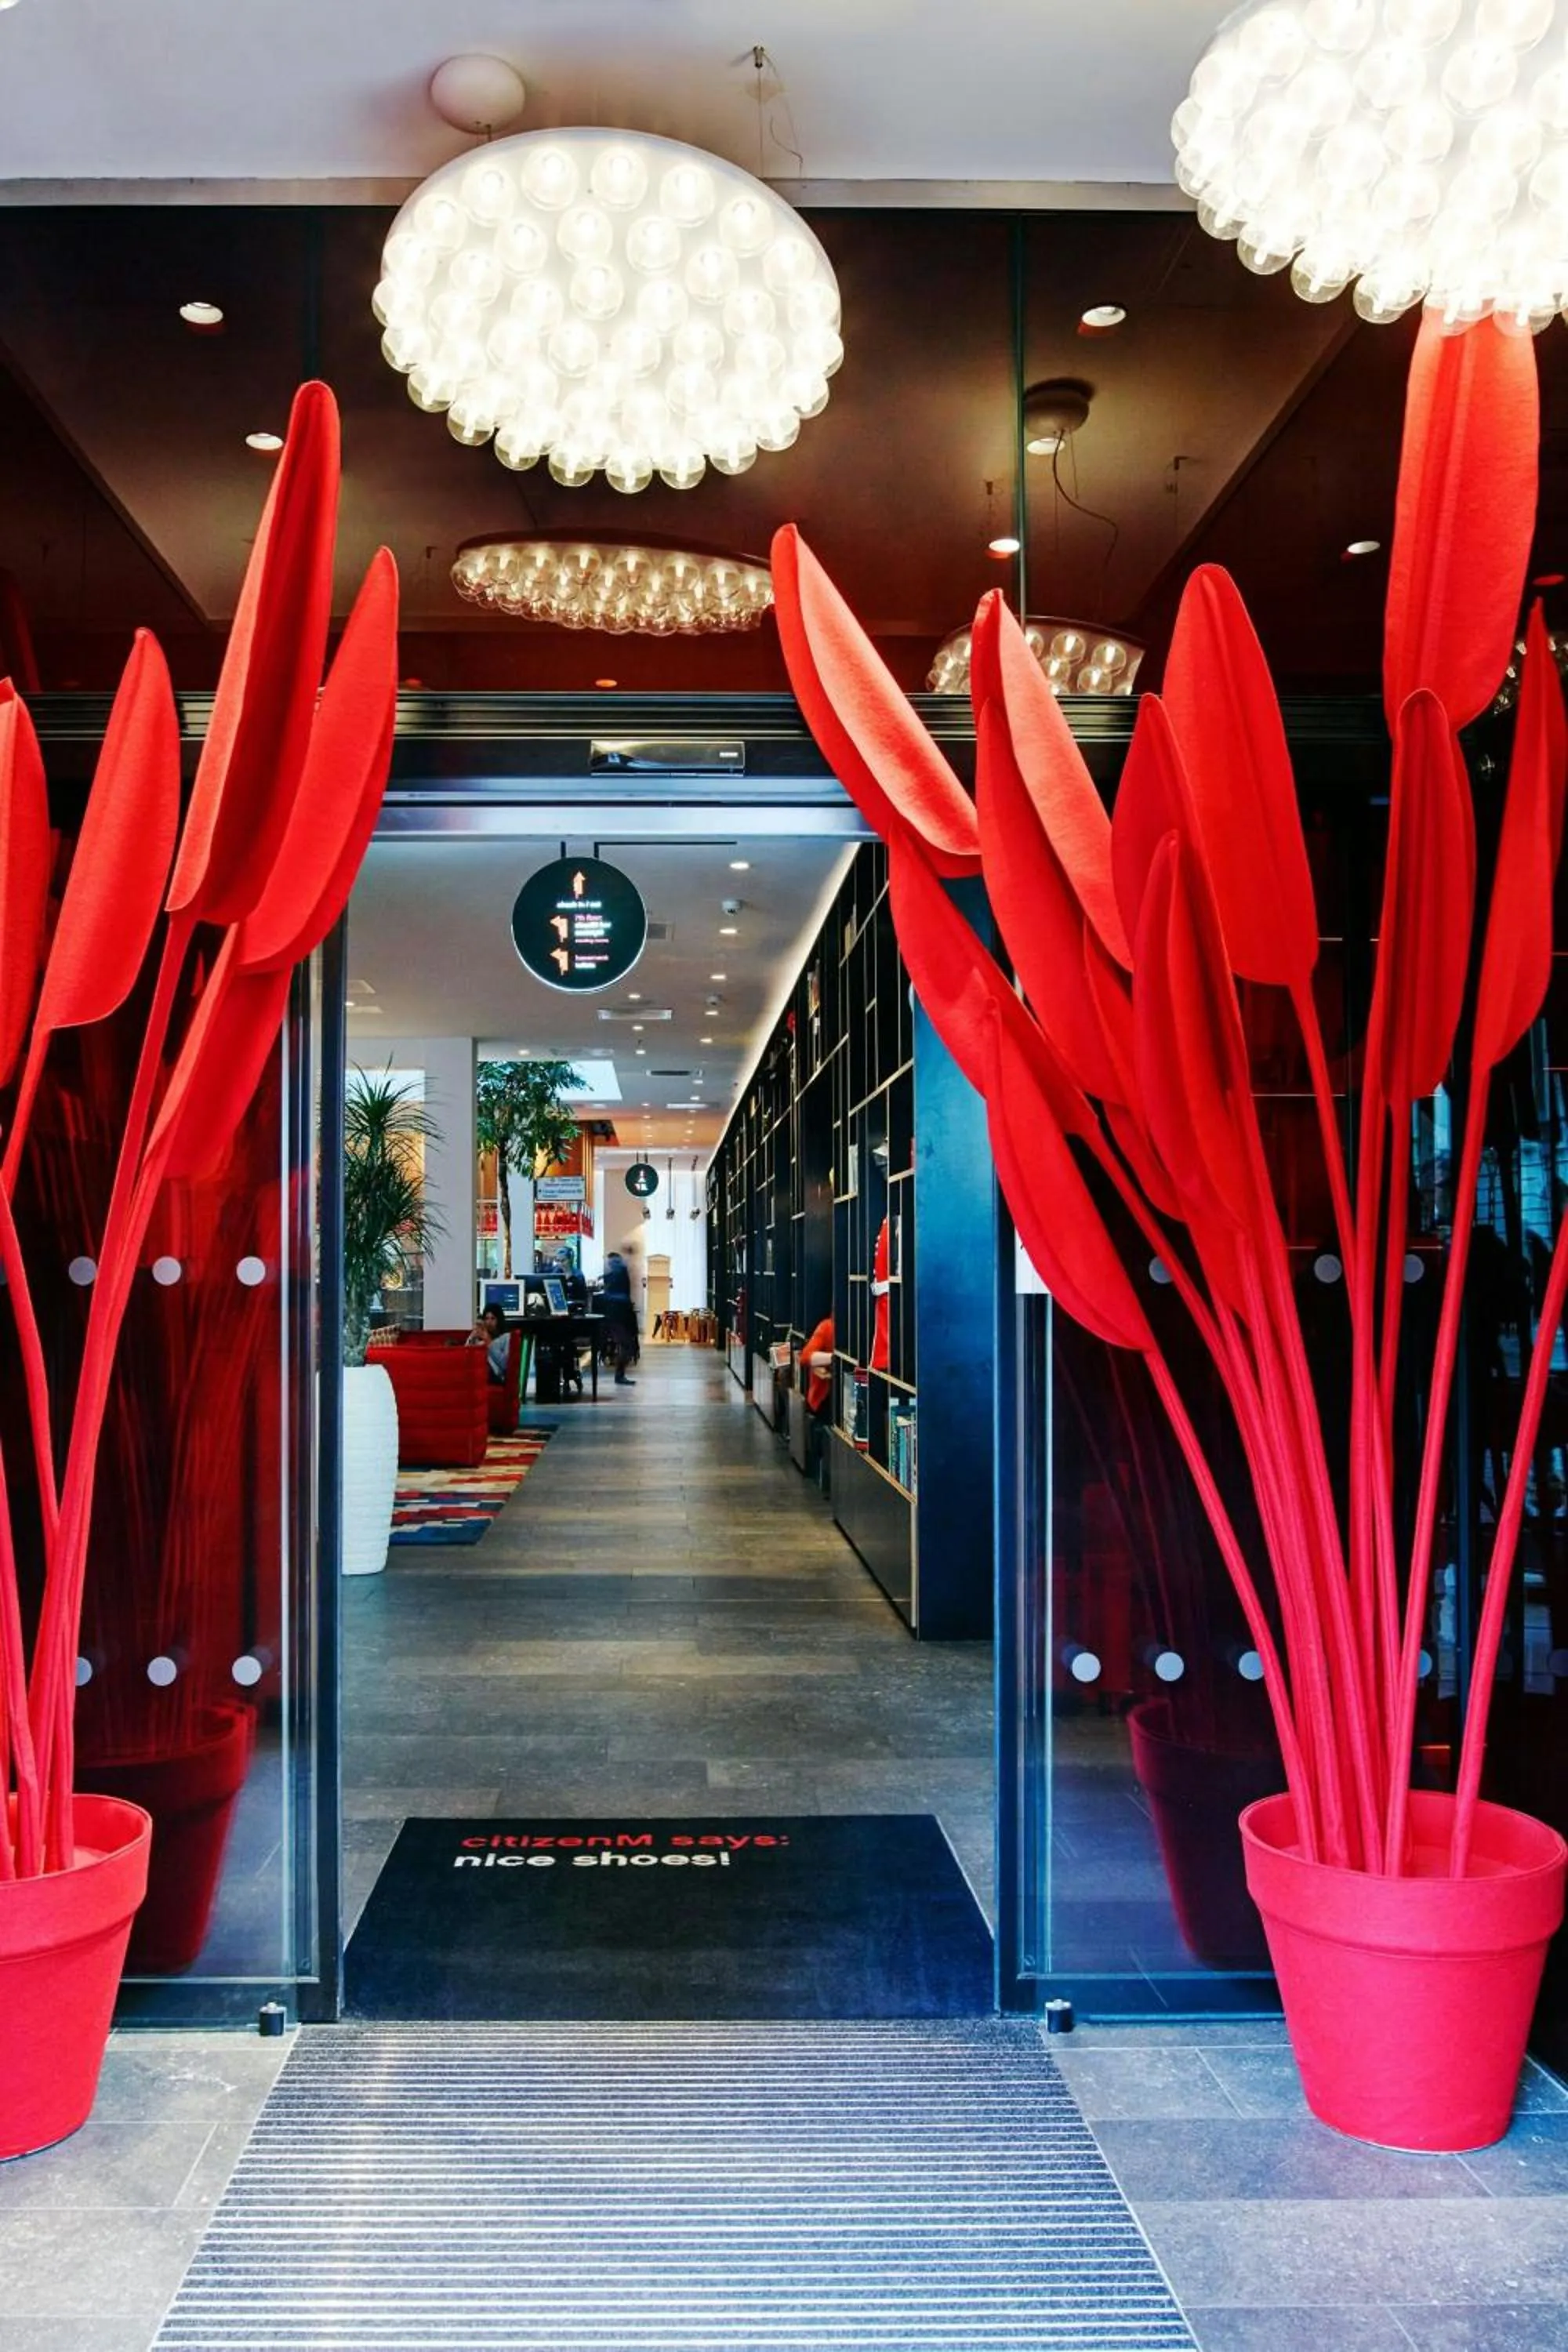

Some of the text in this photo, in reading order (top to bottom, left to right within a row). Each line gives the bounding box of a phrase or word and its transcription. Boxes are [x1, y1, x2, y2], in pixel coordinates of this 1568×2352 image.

[462, 1834, 789, 1849] citizenM says:
[453, 1851, 731, 1867] nice shoes!
